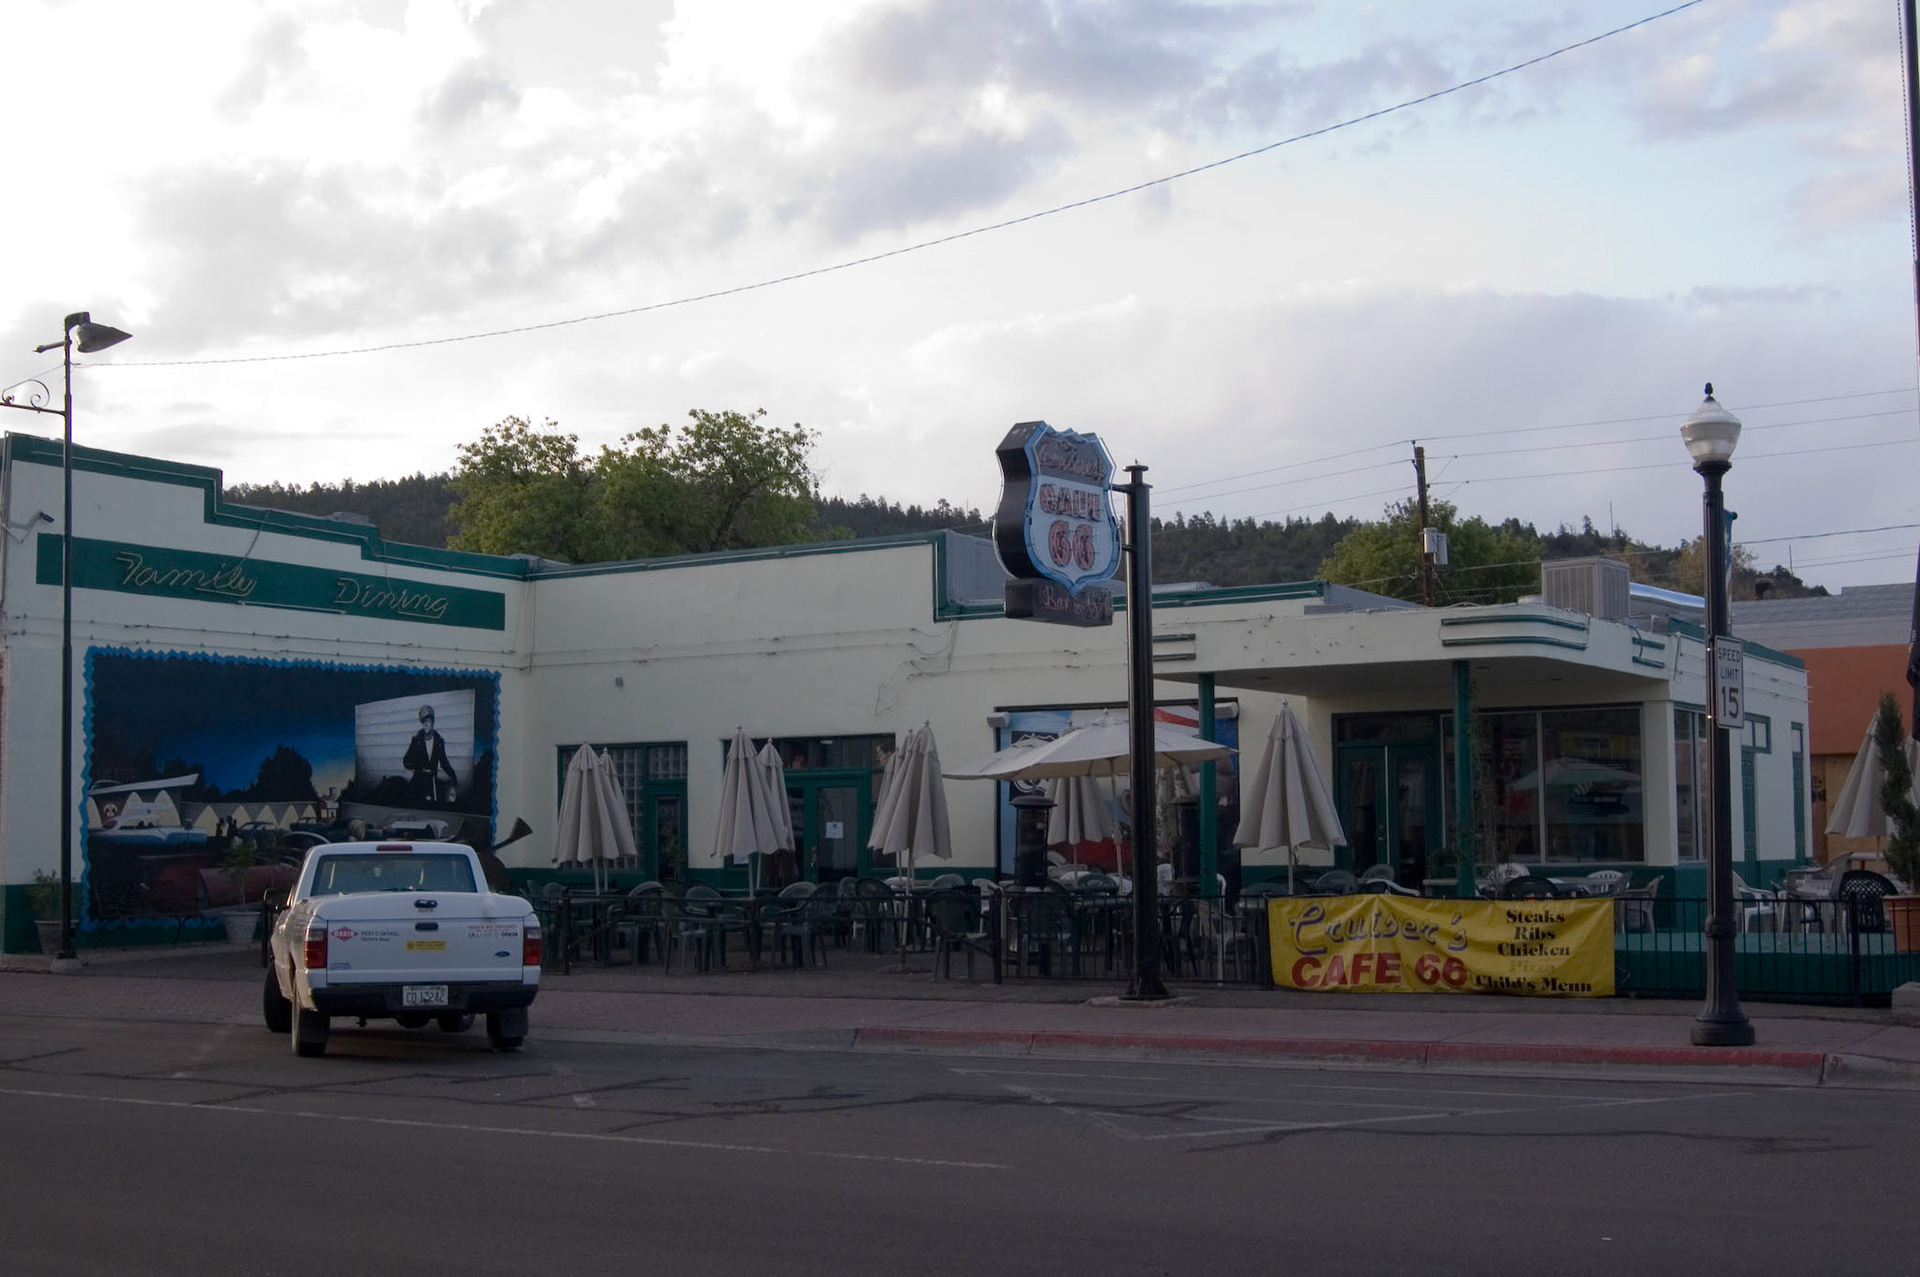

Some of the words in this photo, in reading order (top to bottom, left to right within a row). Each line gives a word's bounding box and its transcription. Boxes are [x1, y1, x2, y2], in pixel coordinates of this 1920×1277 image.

[1048, 520, 1095, 570] 66
[113, 551, 257, 597] Family
[333, 577, 448, 619] Dining
[1718, 647, 1741, 663] SPEED
[1721, 666, 1739, 681] LIMIT
[1721, 685, 1740, 719] 15
[1506, 910, 1566, 924] Steaks
[1290, 901, 1468, 956] Cruiser's
[1514, 926, 1556, 940] Ribs
[1497, 942, 1570, 957] Chicken
[1291, 951, 1401, 987] CAFE
[1414, 953, 1467, 986] 66
[1476, 974, 1536, 990] Child's
[1542, 977, 1592, 992] Menu
